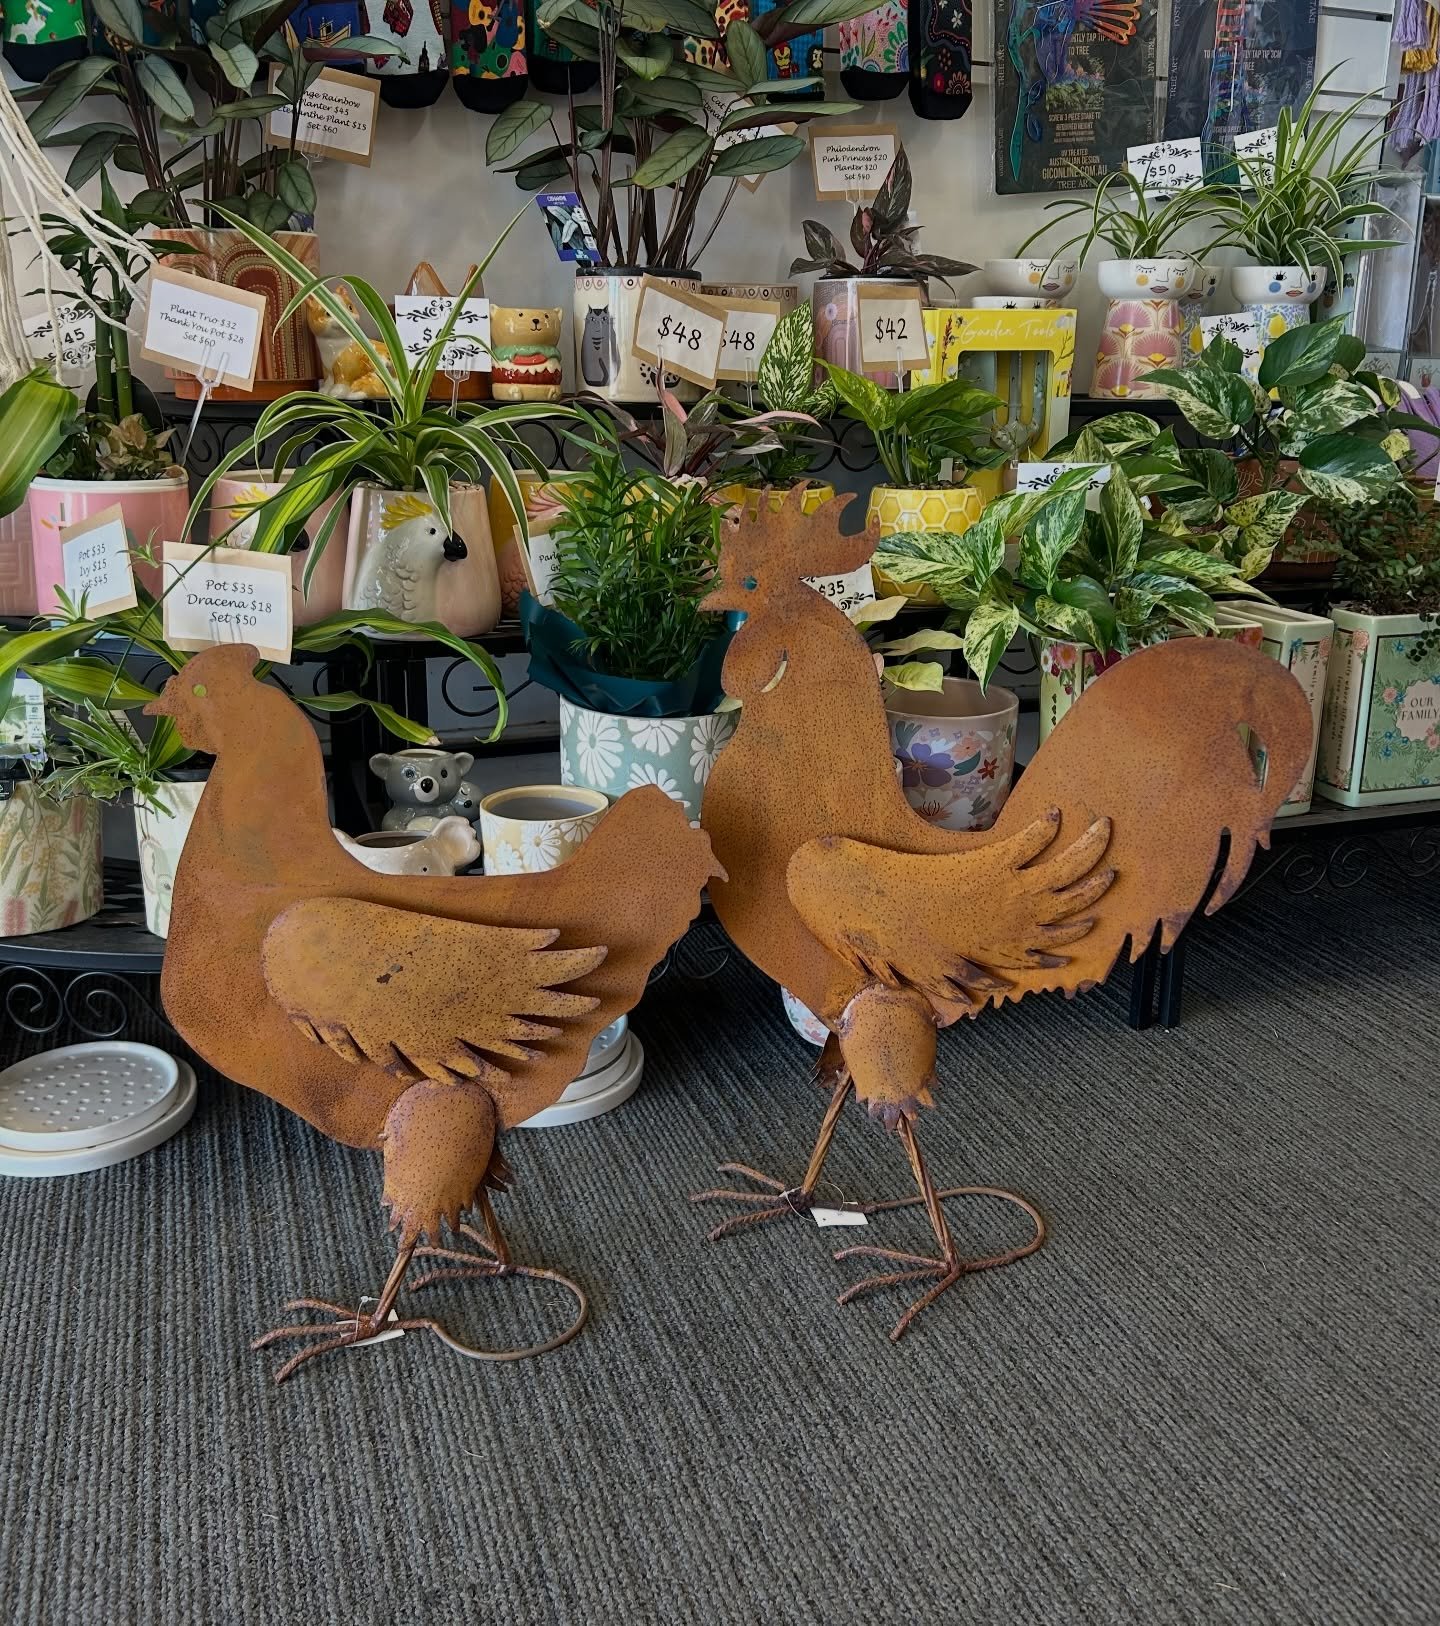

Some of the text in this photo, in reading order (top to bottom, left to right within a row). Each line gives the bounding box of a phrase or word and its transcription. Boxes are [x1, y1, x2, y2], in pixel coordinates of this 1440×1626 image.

[1068, 46, 1090, 55] TO TREE
[321, 92, 361, 109] Rainbow
[334, 105, 349, 116] $45
[307, 121, 338, 134] Set $60
[326, 115, 350, 128] Plant
[351, 121, 367, 131] $15
[826, 145, 880, 153] Philodendron
[822, 155, 840, 163] Pink
[842, 154, 872, 162] Princess
[1150, 164, 1176, 178] $50
[1057, 179, 1092, 189] TREE AR
[170, 304, 238, 330] Plant Trio $32
[160, 312, 245, 345] Thank You Pot $28
[657, 315, 702, 351] $48
[875, 316, 908, 343] $42
[960, 316, 1056, 344] Garden Tools
[183, 331, 216, 347] Set $60
[92, 543, 106, 557] $35
[79, 558, 107, 577] Ivy $15
[206, 579, 254, 595] Pot $35
[187, 593, 272, 614] Dracena $18
[209, 611, 257, 627] Set $50
[1410, 697, 1433, 708] OUR
[1401, 708, 1440, 721] FAMILY
